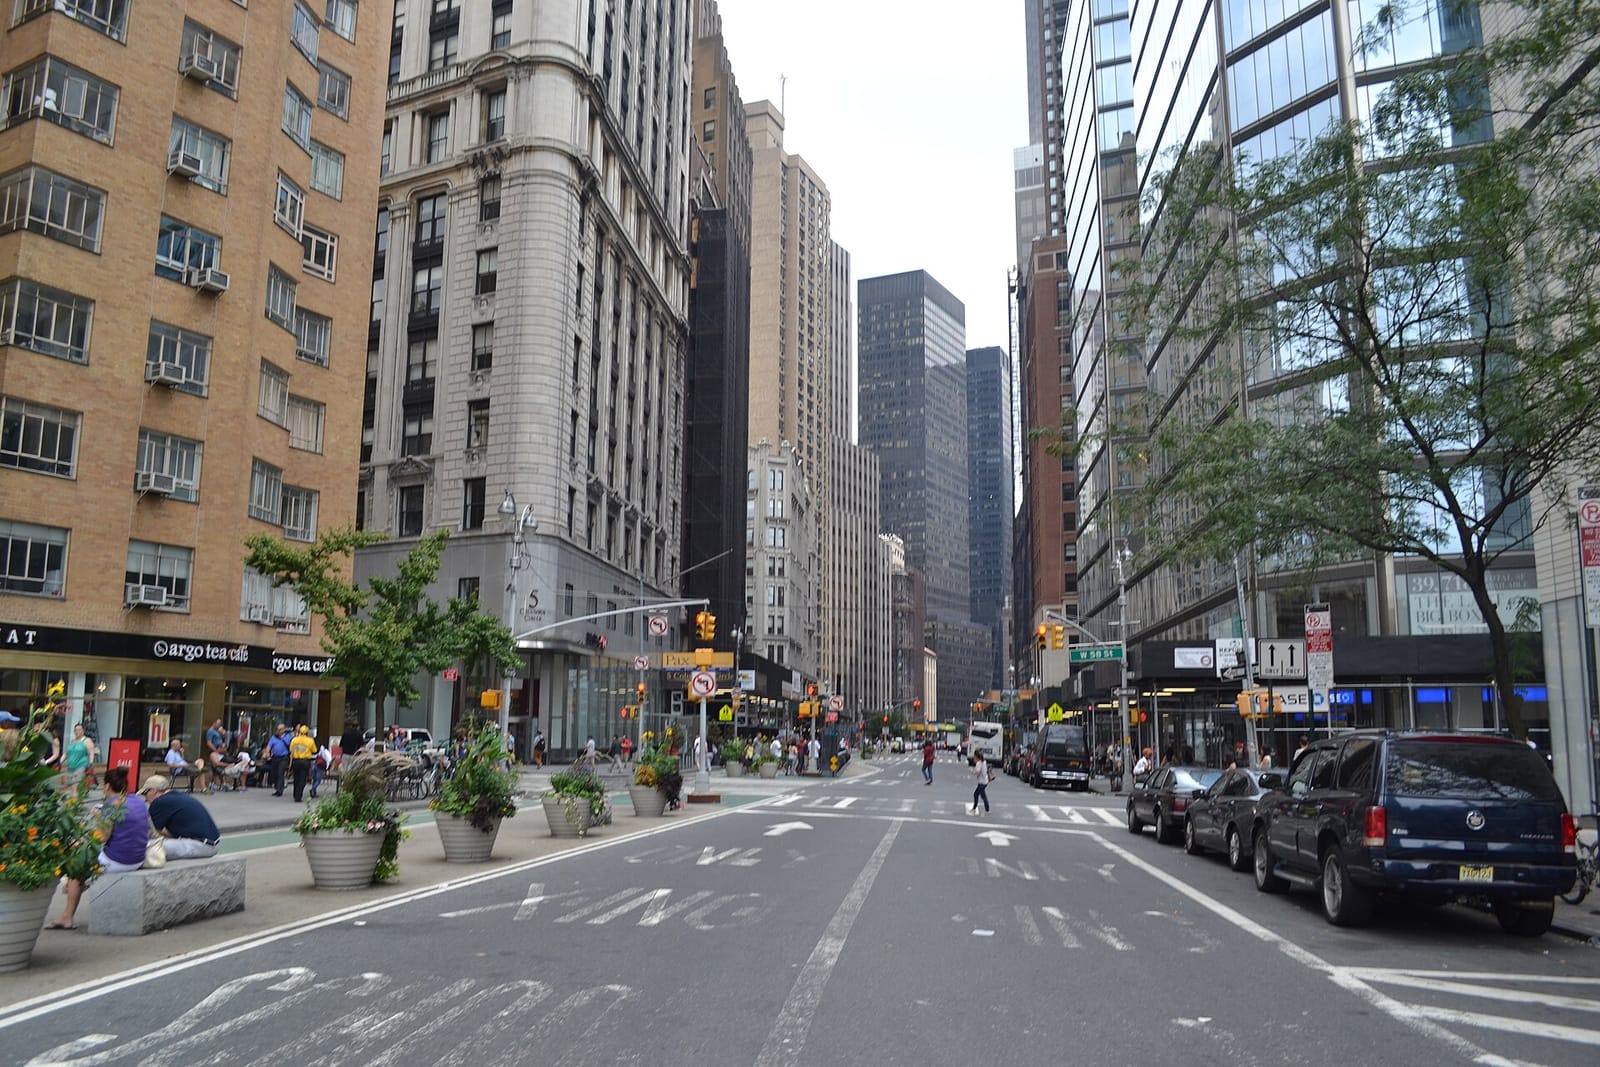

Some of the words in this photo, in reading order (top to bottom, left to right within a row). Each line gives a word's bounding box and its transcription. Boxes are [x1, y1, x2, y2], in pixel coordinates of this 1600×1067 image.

[528, 589, 539, 609] 5
[0, 628, 37, 645] AT
[169, 642, 204, 662] argo
[205, 642, 228, 660] tea
[272, 657, 291, 673] rgo
[293, 657, 311, 672] tea
[1255, 693, 1308, 705] CASE
